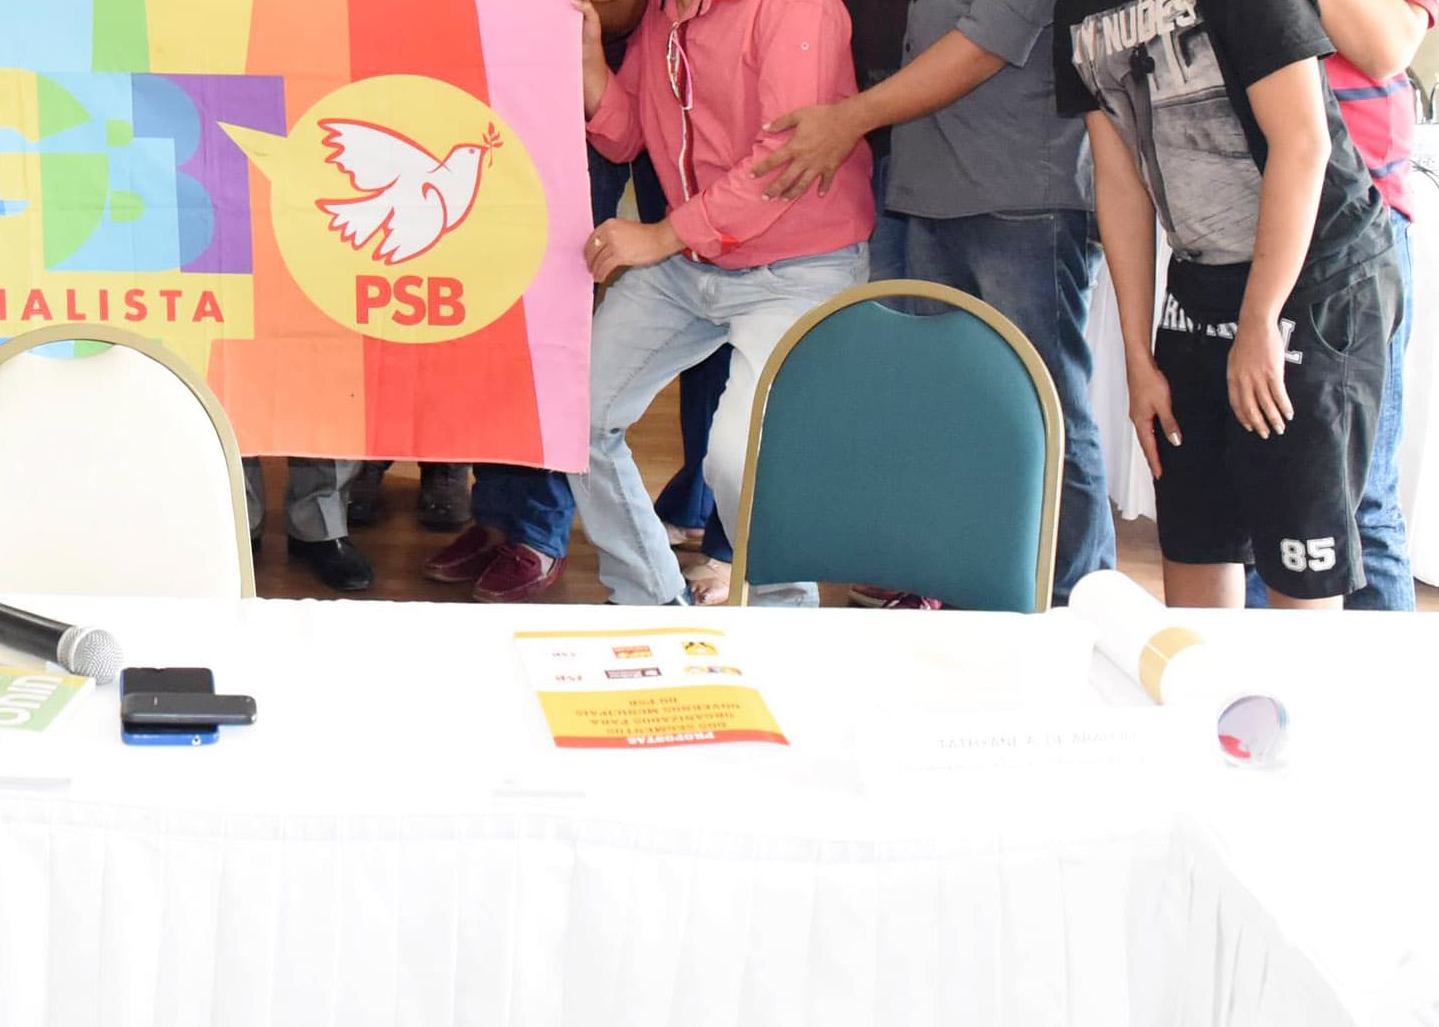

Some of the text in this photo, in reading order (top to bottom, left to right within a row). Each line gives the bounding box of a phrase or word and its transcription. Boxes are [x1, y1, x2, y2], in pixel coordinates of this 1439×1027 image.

[355, 275, 466, 327] PSB
[1280, 537, 1336, 572] 85
[625, 731, 715, 745] PROPOSTAS
